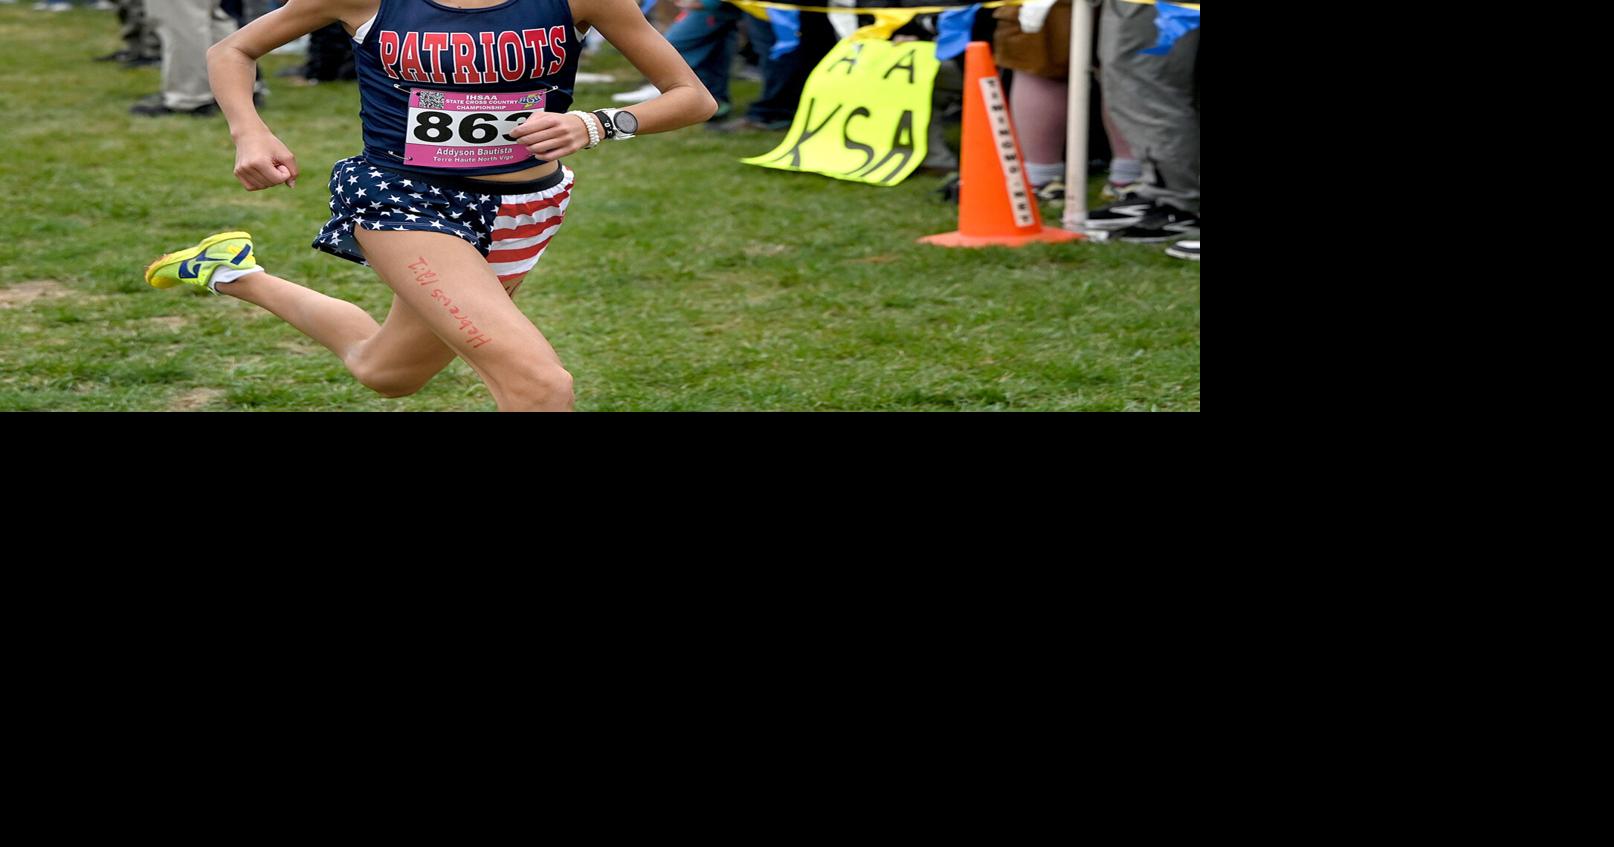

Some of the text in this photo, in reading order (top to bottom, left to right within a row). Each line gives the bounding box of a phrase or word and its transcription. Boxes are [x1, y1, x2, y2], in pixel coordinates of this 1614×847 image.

[379, 25, 567, 84] PATRIOTS
[436, 147, 513, 157] Addyson Bautista
[430, 288, 493, 349] Hebrews
